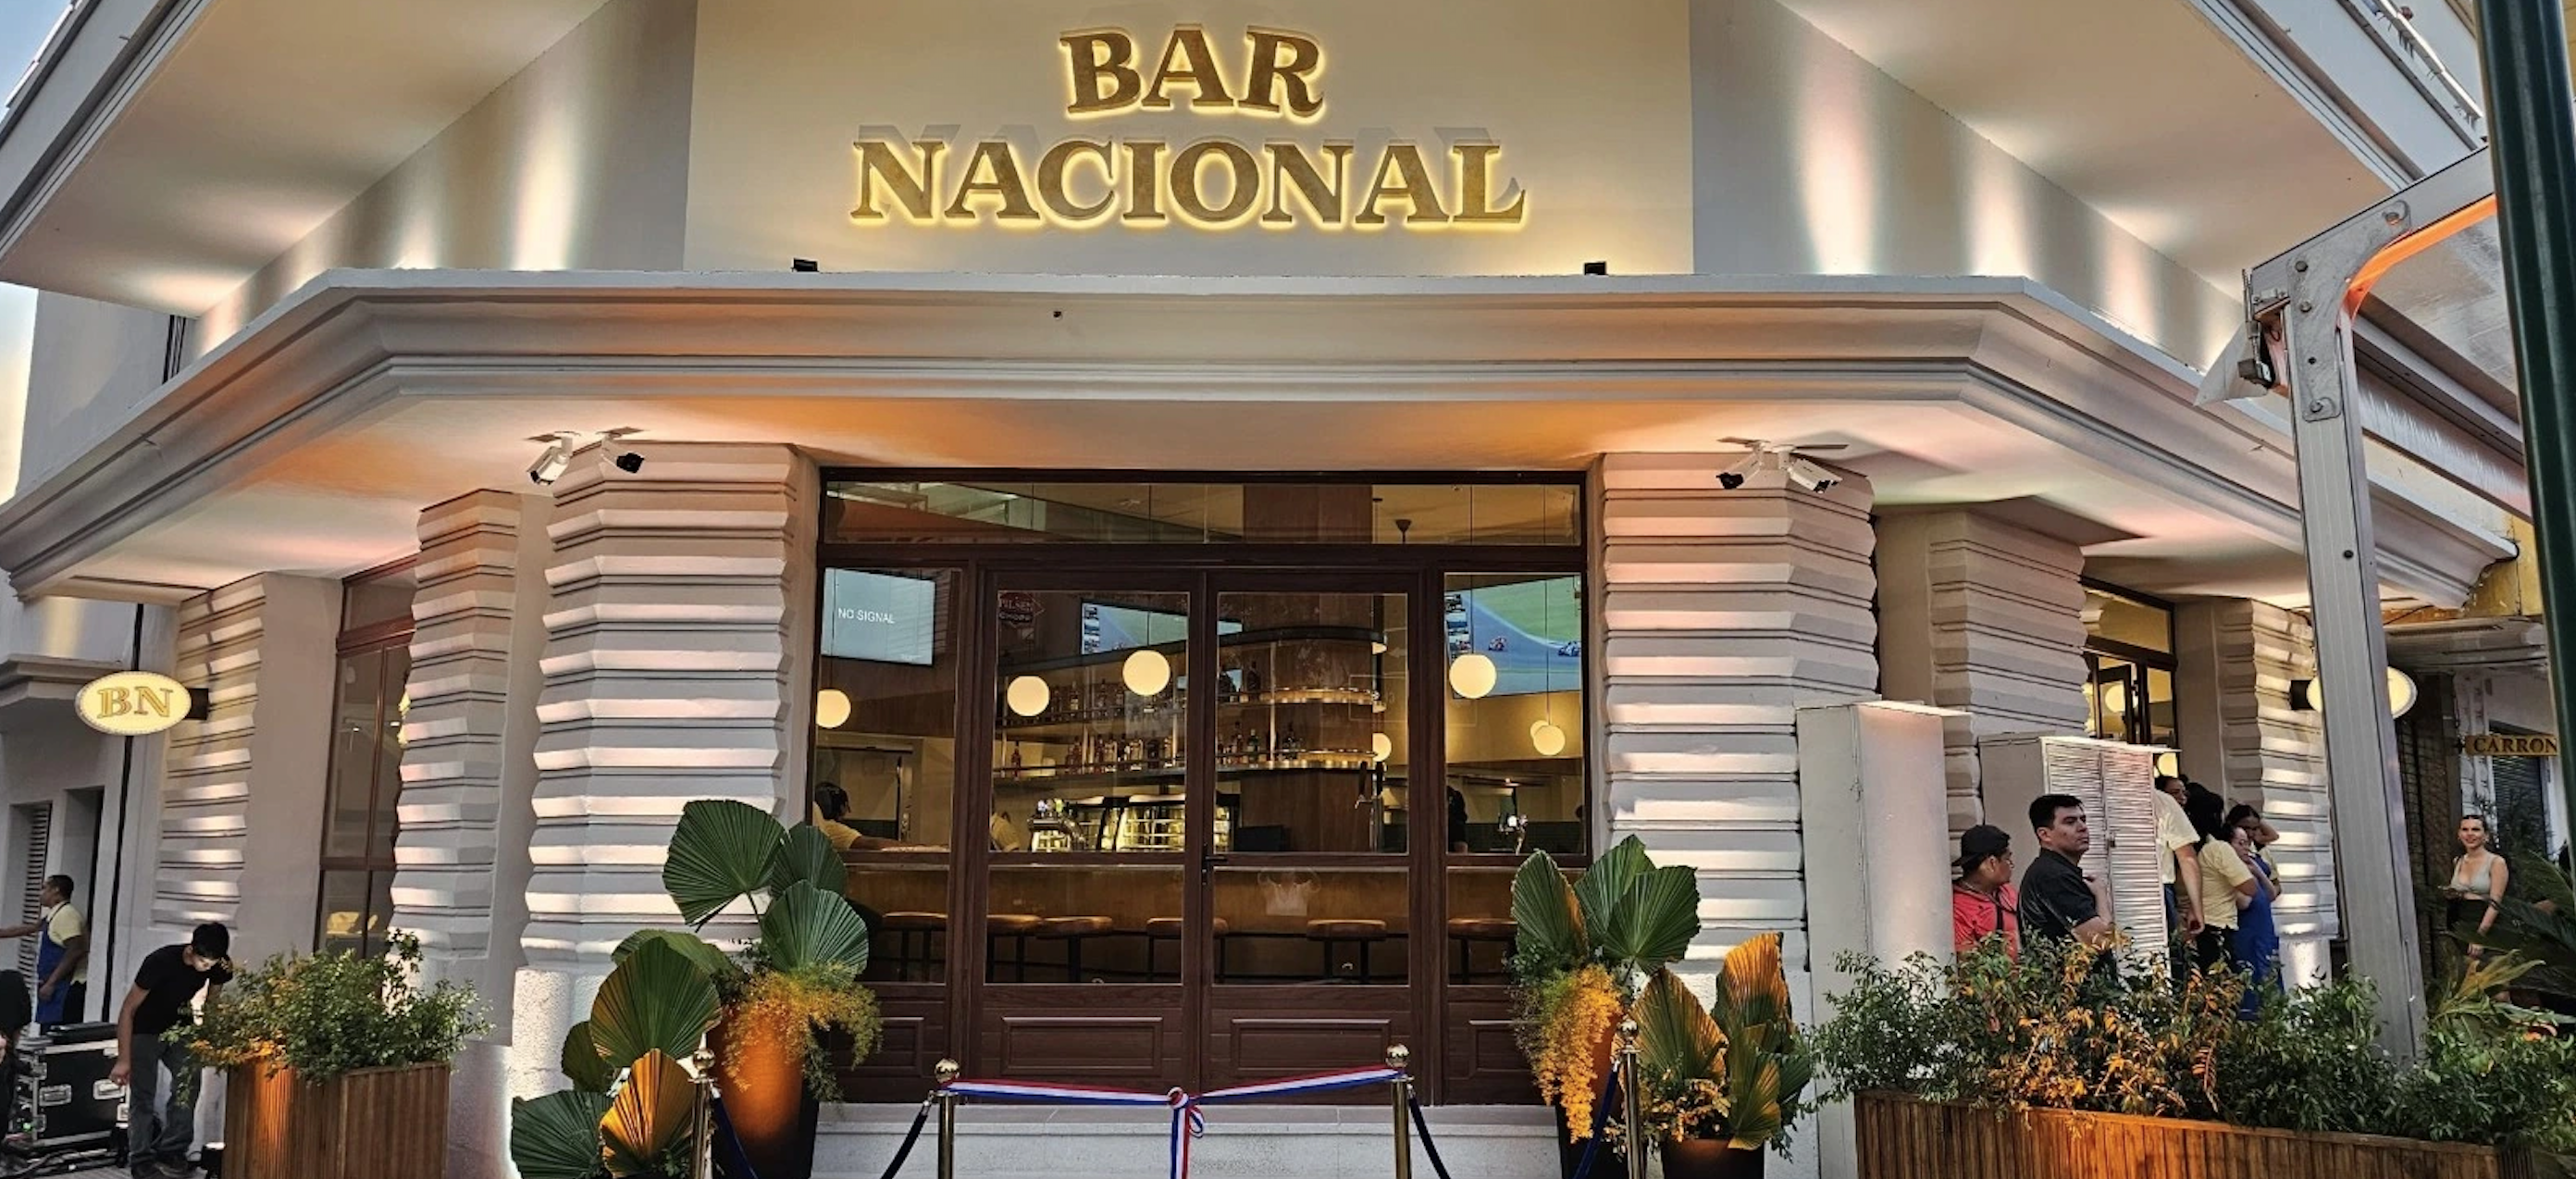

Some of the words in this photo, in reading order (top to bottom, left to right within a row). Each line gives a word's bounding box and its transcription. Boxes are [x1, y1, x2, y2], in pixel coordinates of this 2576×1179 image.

[1059, 24, 1323, 118] BAR
[850, 137, 1526, 226] NACIONAL
[837, 607, 855, 619] NO
[857, 609, 896, 625] SIGNAL
[97, 686, 173, 719] BN
[2474, 738, 2557, 753] CARRON
